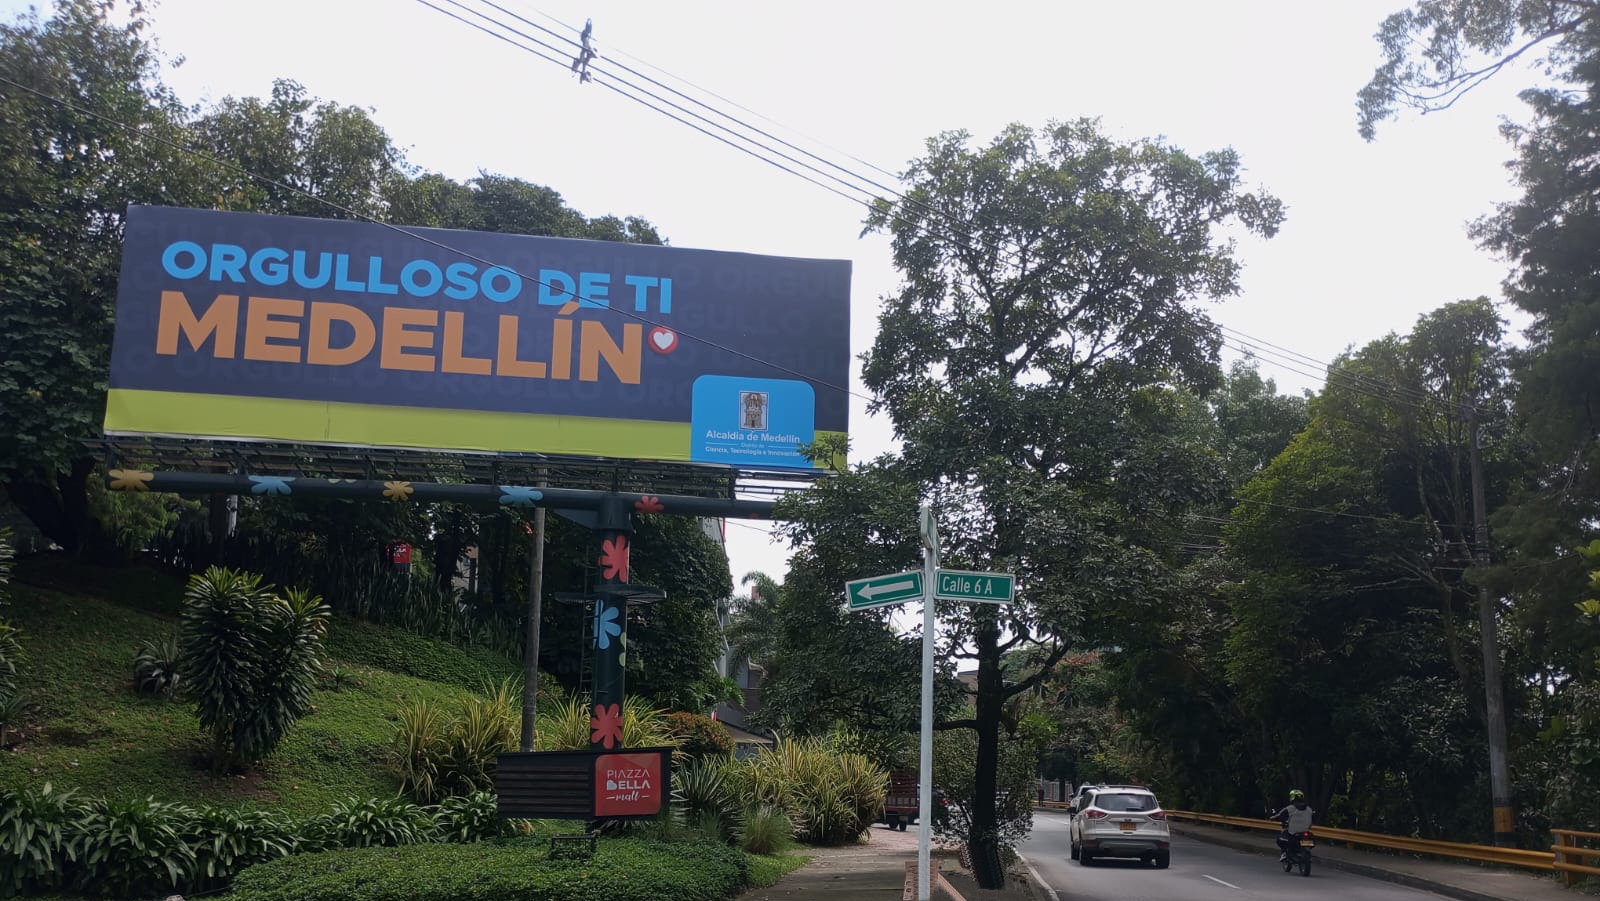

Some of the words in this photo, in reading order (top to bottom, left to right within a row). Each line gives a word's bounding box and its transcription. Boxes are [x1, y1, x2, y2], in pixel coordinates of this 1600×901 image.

[161, 240, 523, 303] ORGULLOSO
[538, 268, 611, 310] DE
[625, 274, 673, 314] TI
[156, 290, 643, 385] MEDELLÍN
[747, 432, 758, 441] de
[761, 433, 800, 444] Medellín
[942, 576, 970, 593] Calle
[975, 578, 982, 594] 6
[984, 579, 993, 595] A
[607, 769, 651, 779] PIAZZA
